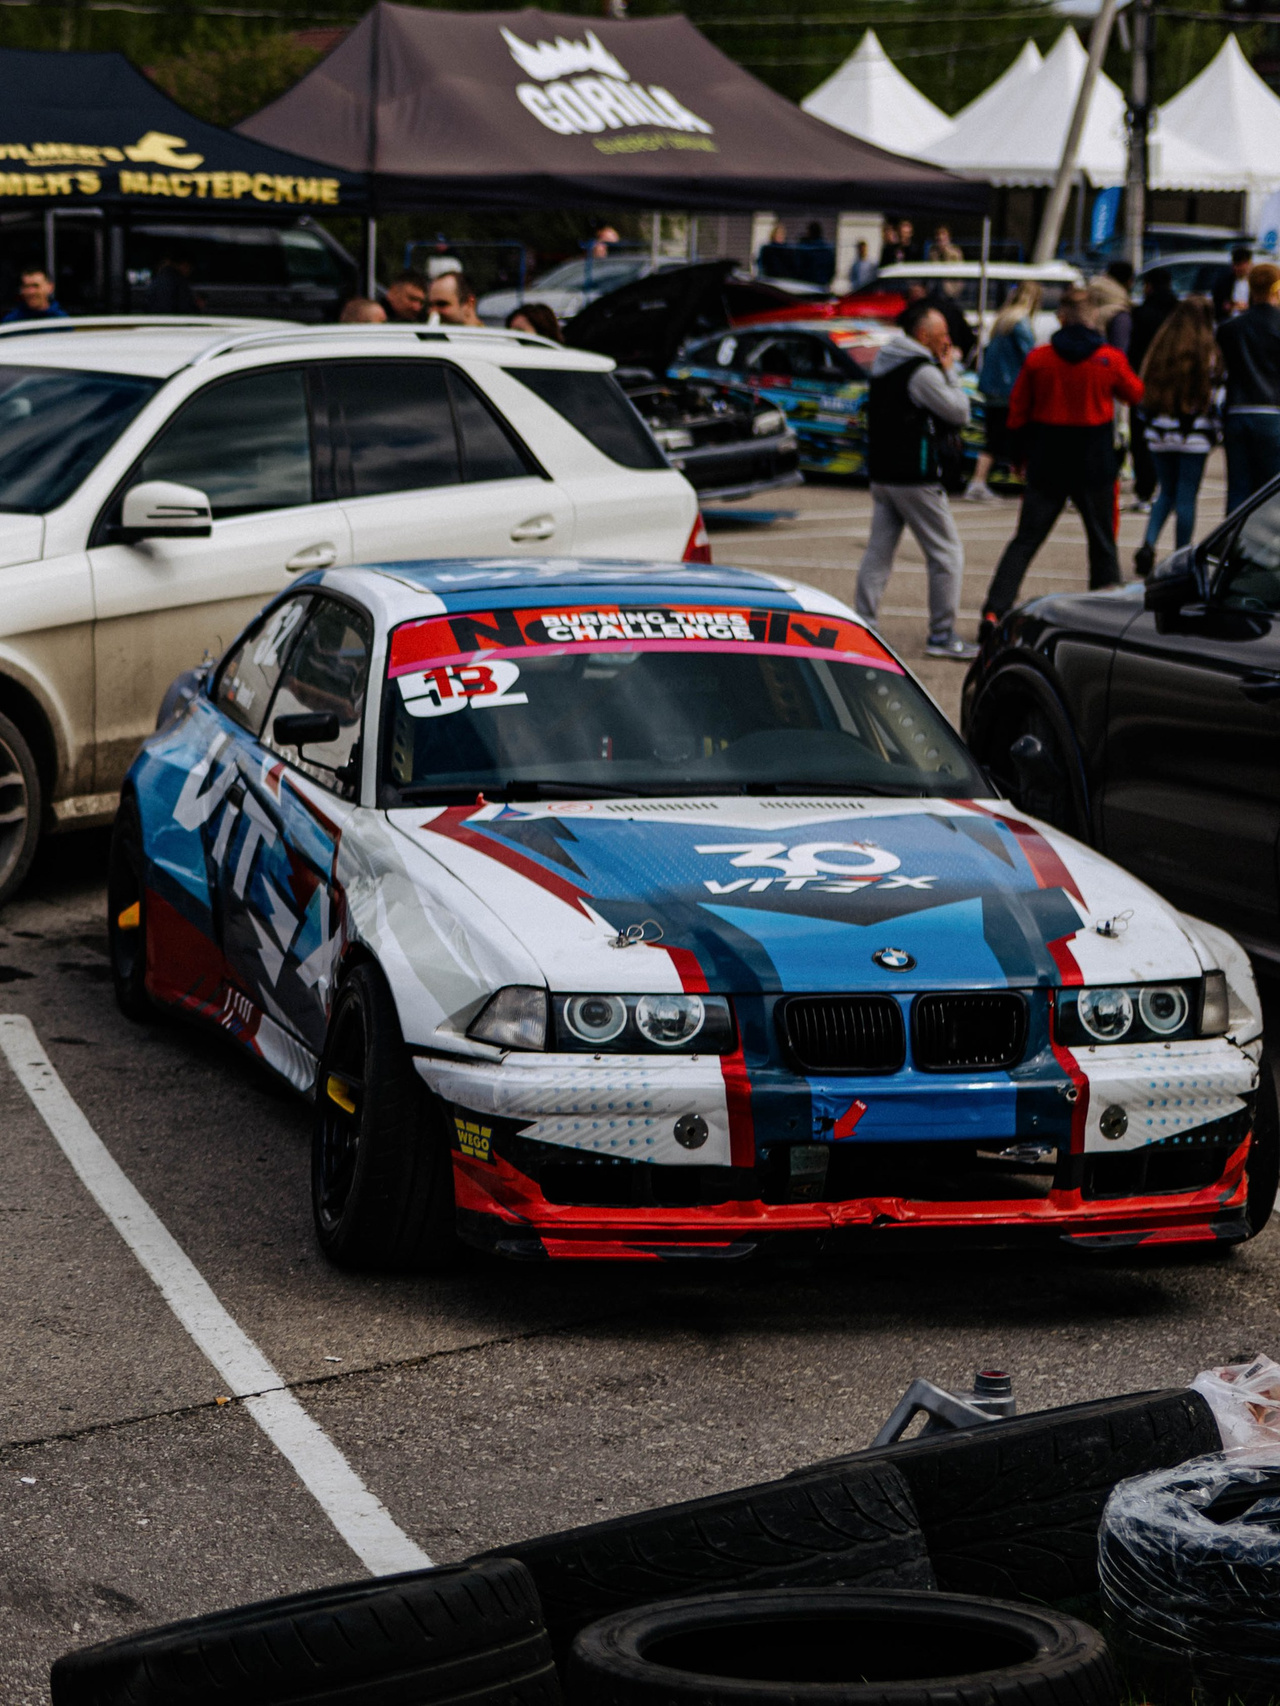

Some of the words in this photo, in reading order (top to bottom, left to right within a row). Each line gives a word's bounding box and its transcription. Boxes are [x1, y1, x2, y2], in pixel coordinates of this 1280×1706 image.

[516, 75, 714, 135] GORILLA
[119, 169, 341, 205] МАСТЕРСКИЕ
[540, 611, 666, 628] BURNING
[670, 612, 748, 627] TIRES
[547, 623, 756, 641] CHALLENGE
[694, 842, 902, 877] 30
[457, 1129, 489, 1151] WEGO
